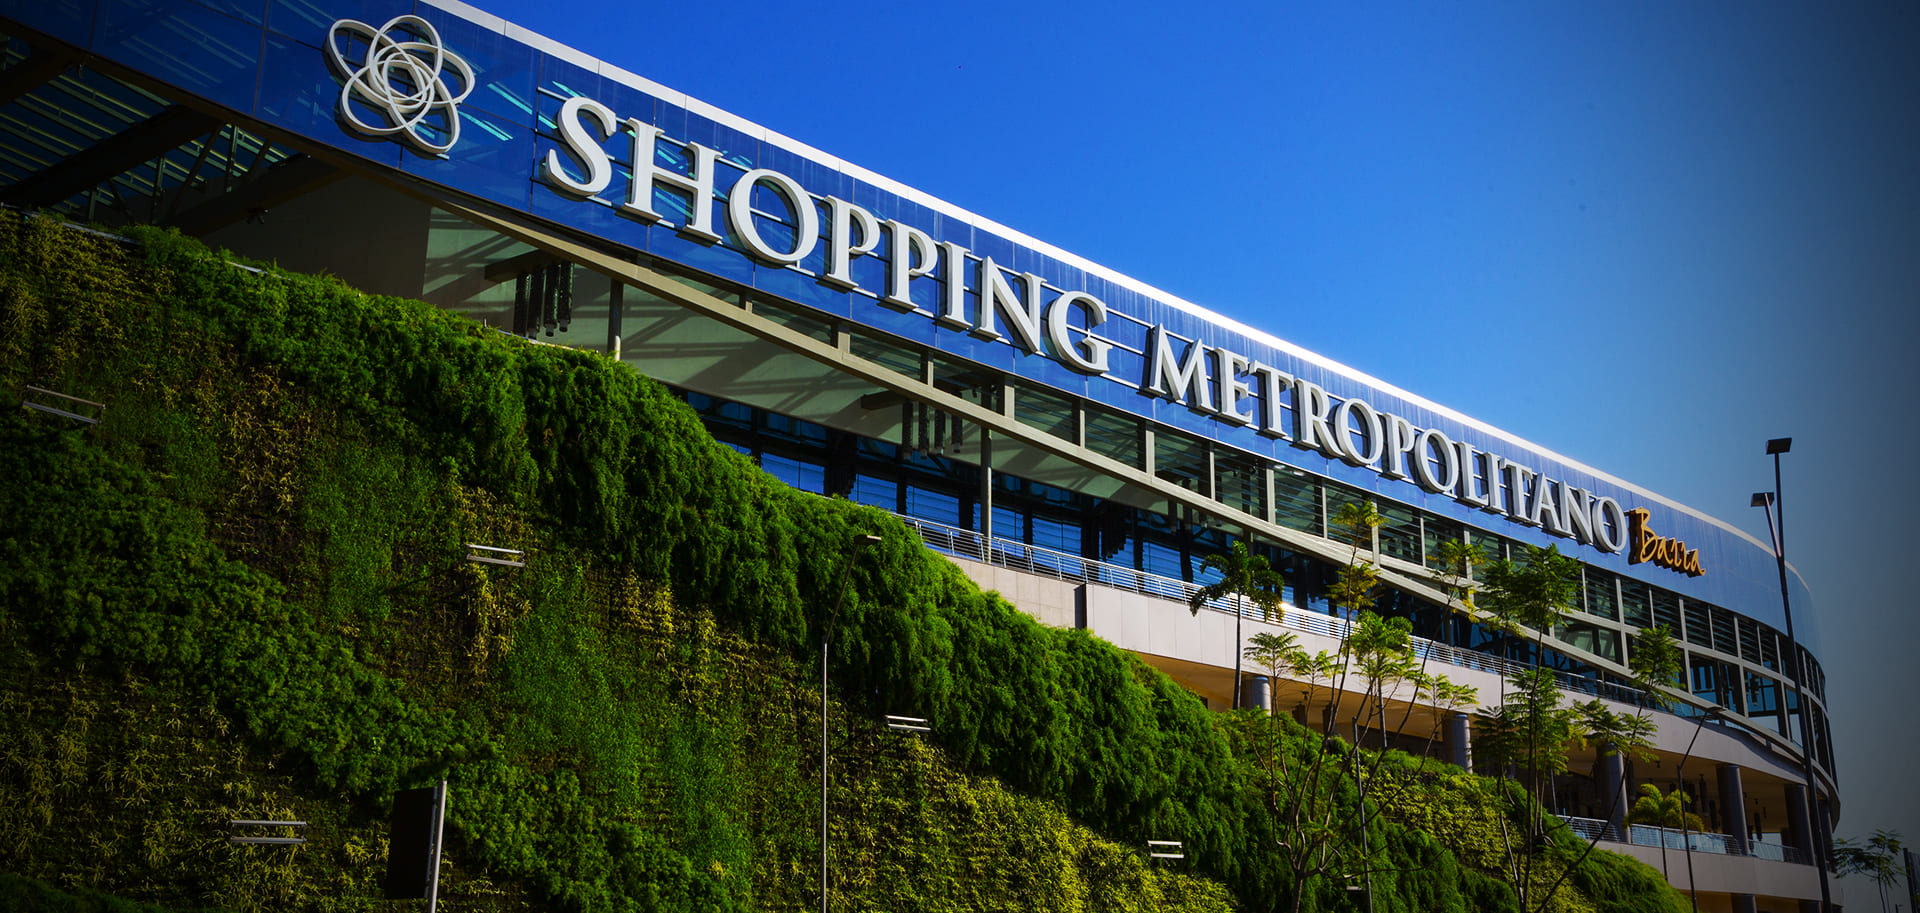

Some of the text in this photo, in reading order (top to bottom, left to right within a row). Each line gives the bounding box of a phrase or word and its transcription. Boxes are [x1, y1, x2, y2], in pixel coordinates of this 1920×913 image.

[543, 97, 1706, 577] SHOPPING METROPOLITANO Barra
